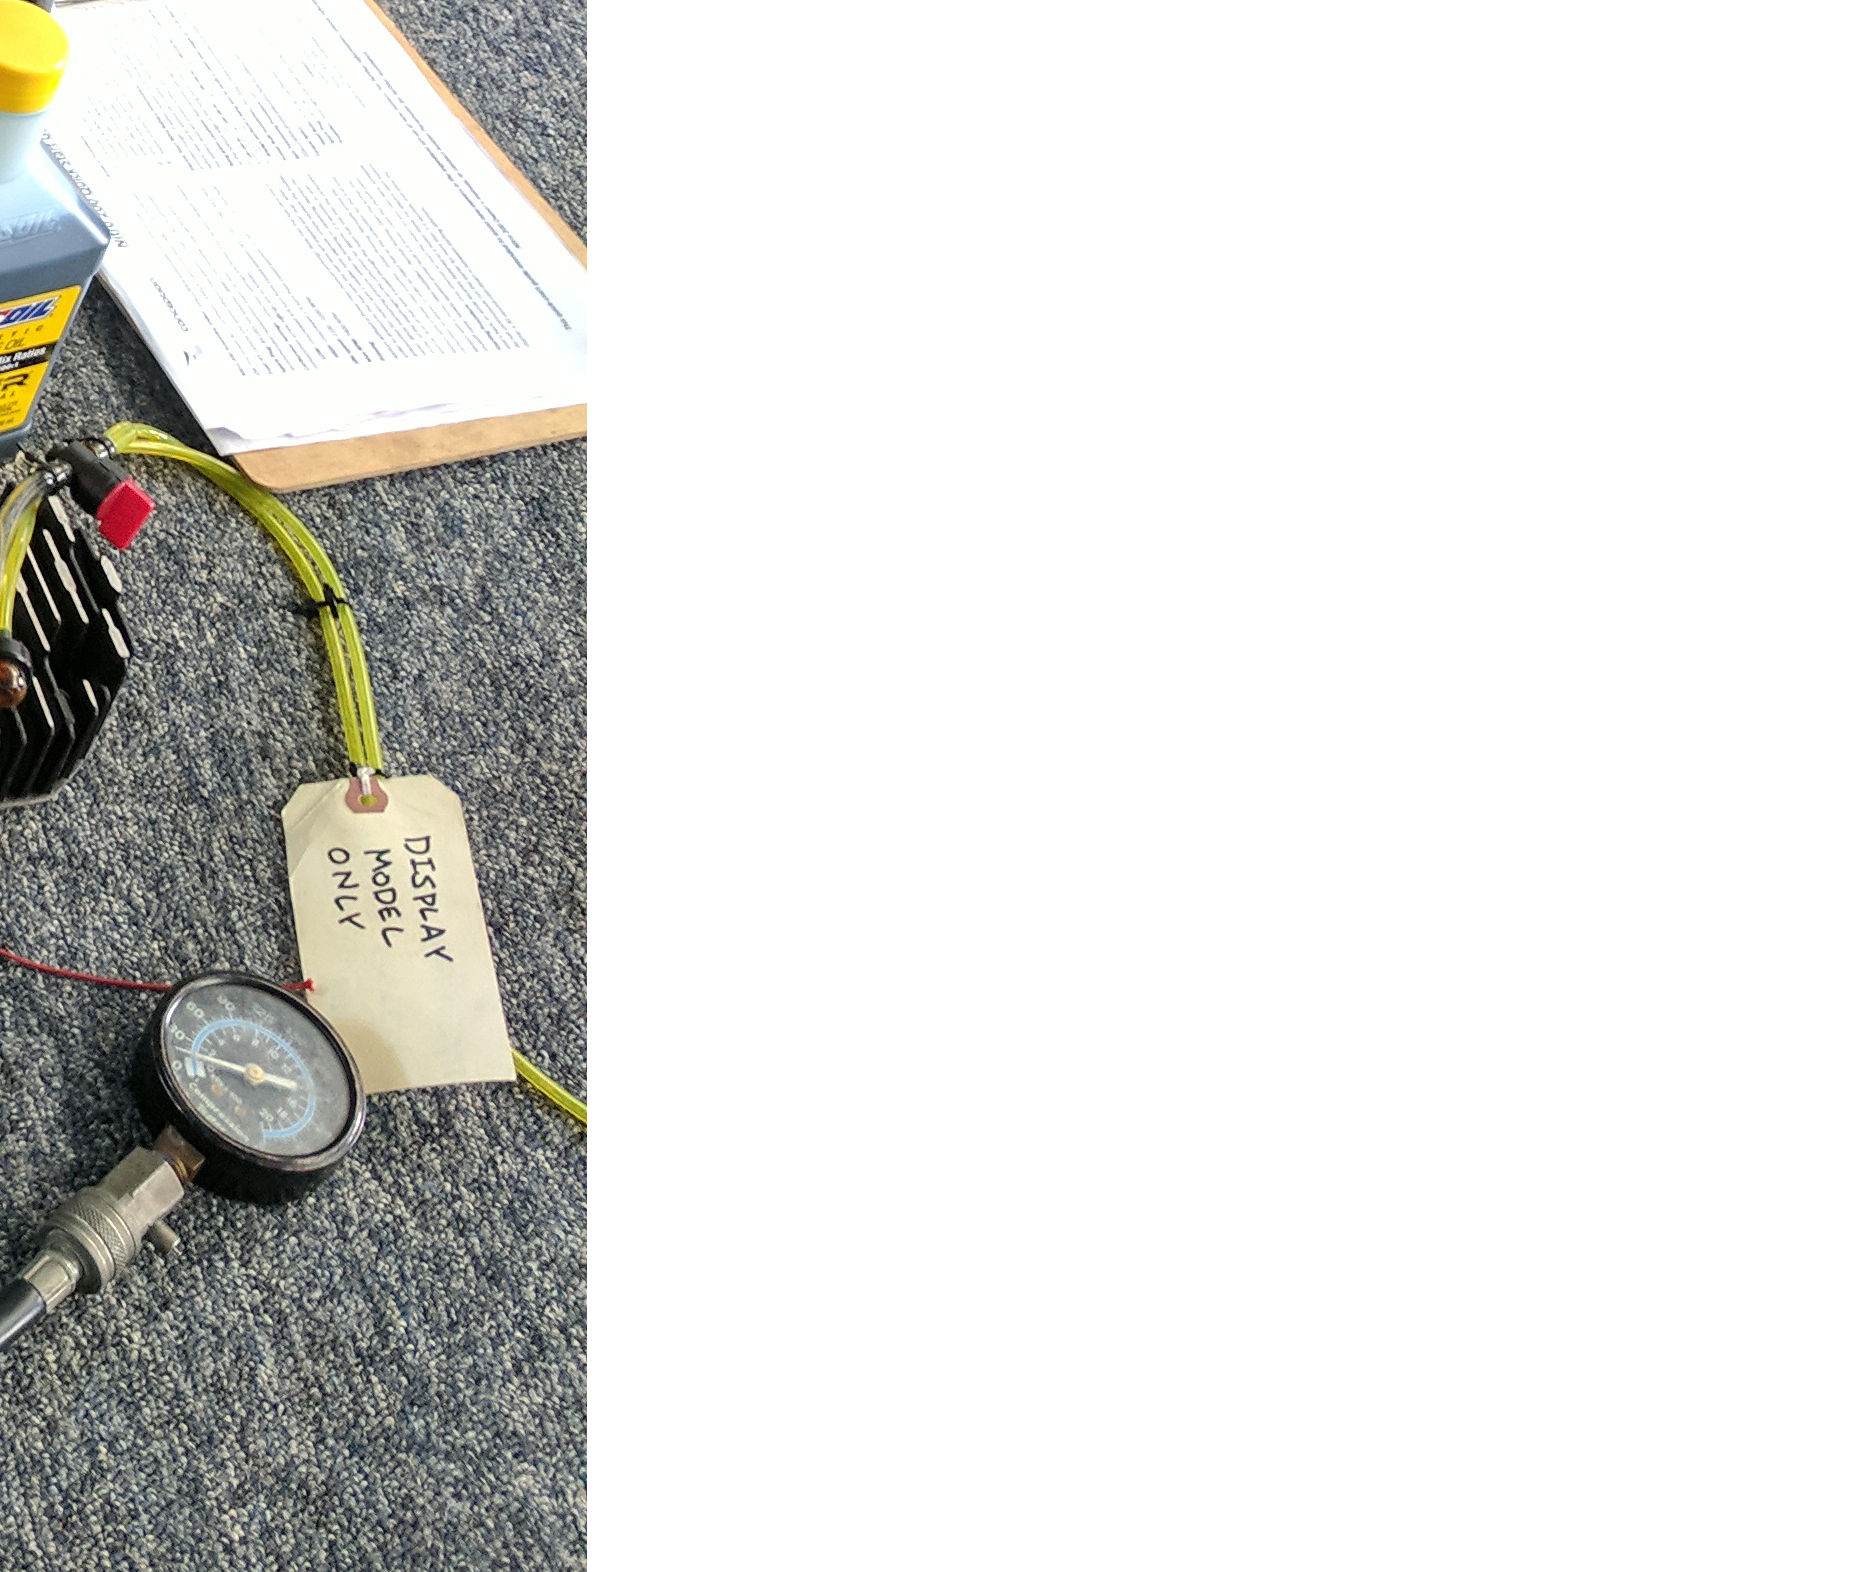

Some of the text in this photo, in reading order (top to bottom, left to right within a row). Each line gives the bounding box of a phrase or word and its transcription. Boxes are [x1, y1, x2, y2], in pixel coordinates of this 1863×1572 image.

[4, 336, 26, 351] OIL
[13, 347, 47, 363] Ratios
[327, 846, 367, 930] ONLY
[363, 848, 404, 948] MODEL
[403, 835, 454, 963] DISPLAY
